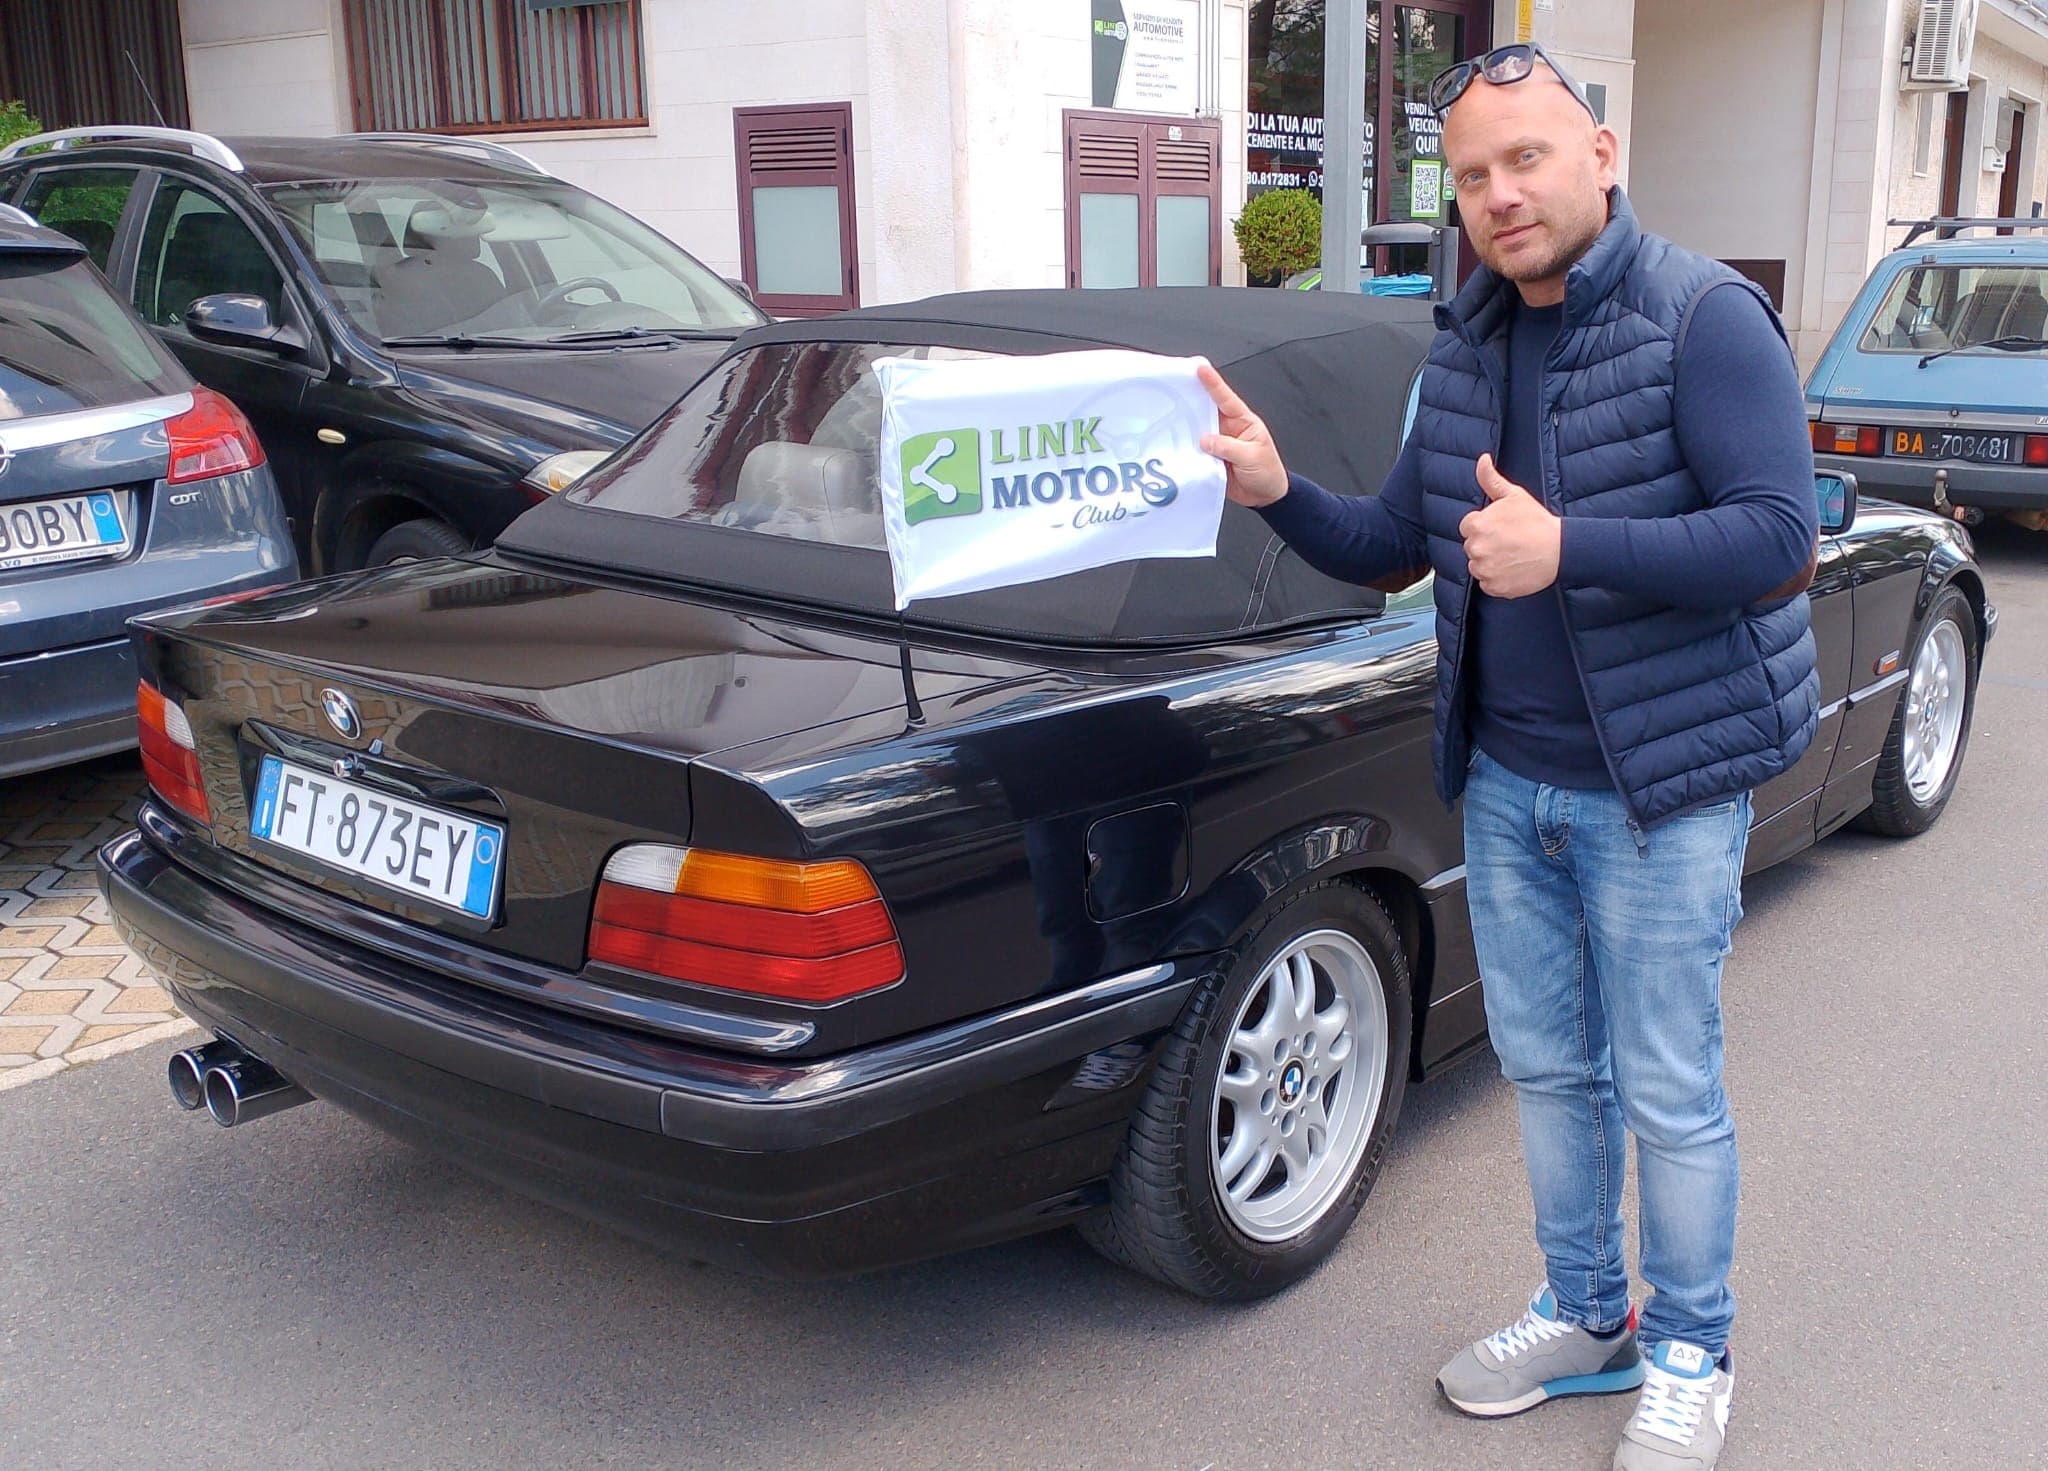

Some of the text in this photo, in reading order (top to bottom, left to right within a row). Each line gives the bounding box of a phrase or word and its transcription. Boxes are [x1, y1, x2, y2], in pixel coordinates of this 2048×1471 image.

[1133, 22, 1184, 38] AUTOMOTIVE
[1404, 102, 1427, 115] VENDI
[1261, 113, 1276, 131] LA
[1277, 114, 1299, 133] TUA
[1301, 117, 1324, 136] AUT
[1288, 135, 1293, 150] E
[1294, 136, 1305, 151] AL
[1415, 135, 1438, 155] QUI!
[989, 416, 1104, 465] LINK
[1895, 431, 2010, 460] BA 703481
[991, 458, 1178, 509] MOTORS
[1072, 503, 1127, 530] Club
